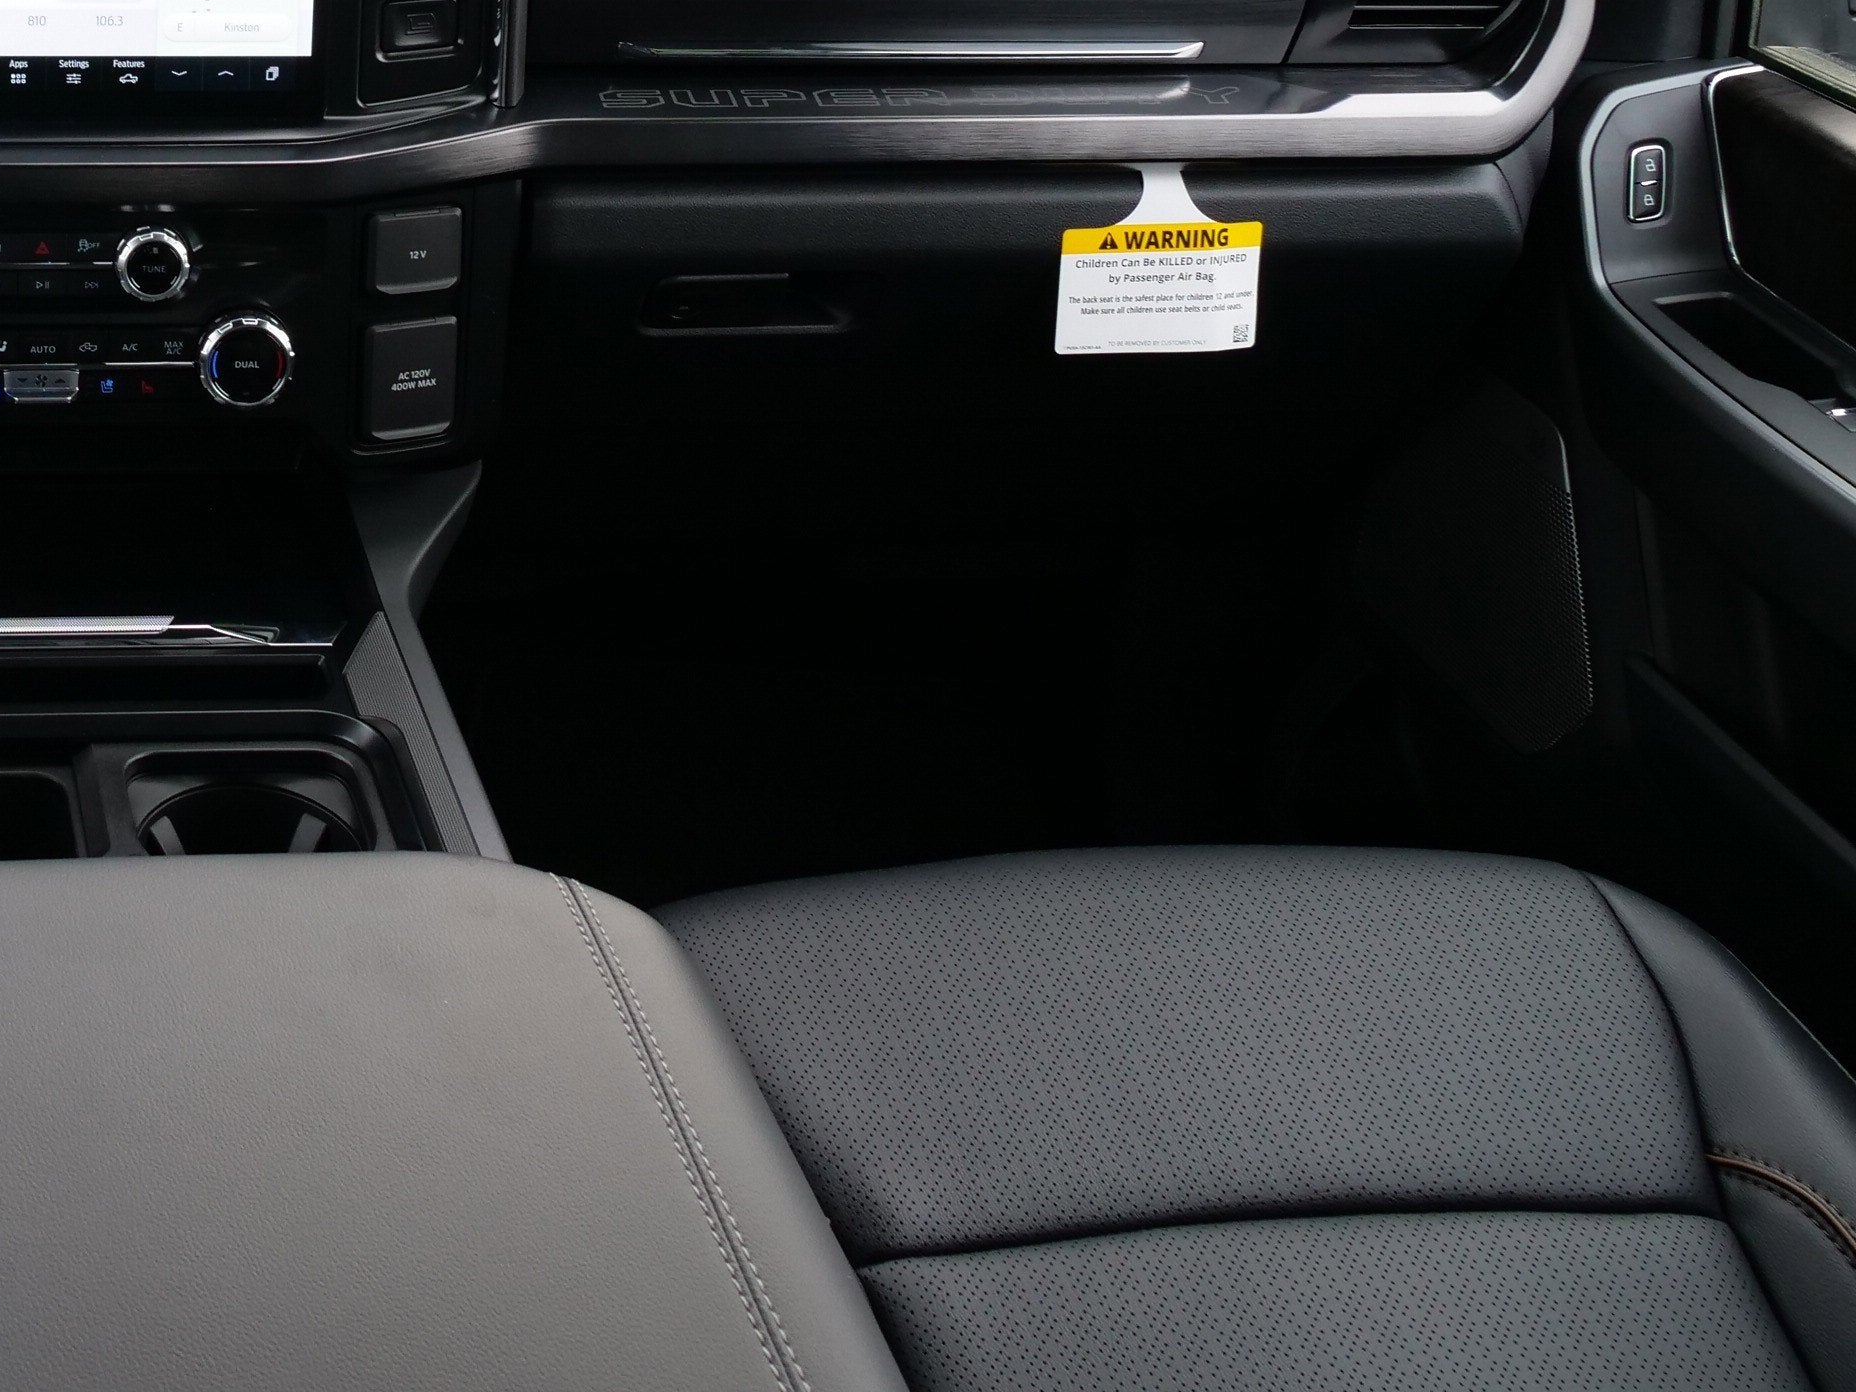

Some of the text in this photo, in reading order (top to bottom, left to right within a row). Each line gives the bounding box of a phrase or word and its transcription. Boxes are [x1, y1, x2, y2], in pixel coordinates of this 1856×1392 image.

[27, 15, 47, 26] 810
[95, 15, 124, 26] 106.3
[224, 22, 260, 32] Kinston
[9, 60, 29, 69] Apps
[58, 60, 90, 70] Settings
[113, 59, 145, 68] Features
[598, 88, 952, 108] SUPER
[1123, 227, 1230, 250] WARNING
[1075, 253, 1248, 269] Children Can Be KILLED or INJURED
[142, 265, 166, 273] TUNE
[1108, 271, 1217, 286] by Passenger Air Bag.
[1068, 296, 1081, 305] The
[1082, 295, 1099, 304] back
[1099, 296, 1113, 304] seat
[1121, 295, 1133, 303] the
[1134, 294, 1155, 303] safest
[1155, 294, 1174, 303] place
[1174, 293, 1185, 302] for
[1186, 293, 1214, 302] children
[1215, 292, 1223, 300] 12
[1224, 291, 1235, 299] and
[1080, 303, 1226, 316] Make sure all children use seat belts child
[30, 345, 56, 354] AUTO
[122, 343, 139, 352] A/C
[164, 340, 184, 349] MAX
[166, 348, 182, 356] A/C
[234, 360, 260, 369] DUAL
[397, 368, 432, 381] AC 120V
[390, 377, 438, 392] 400W MAX
